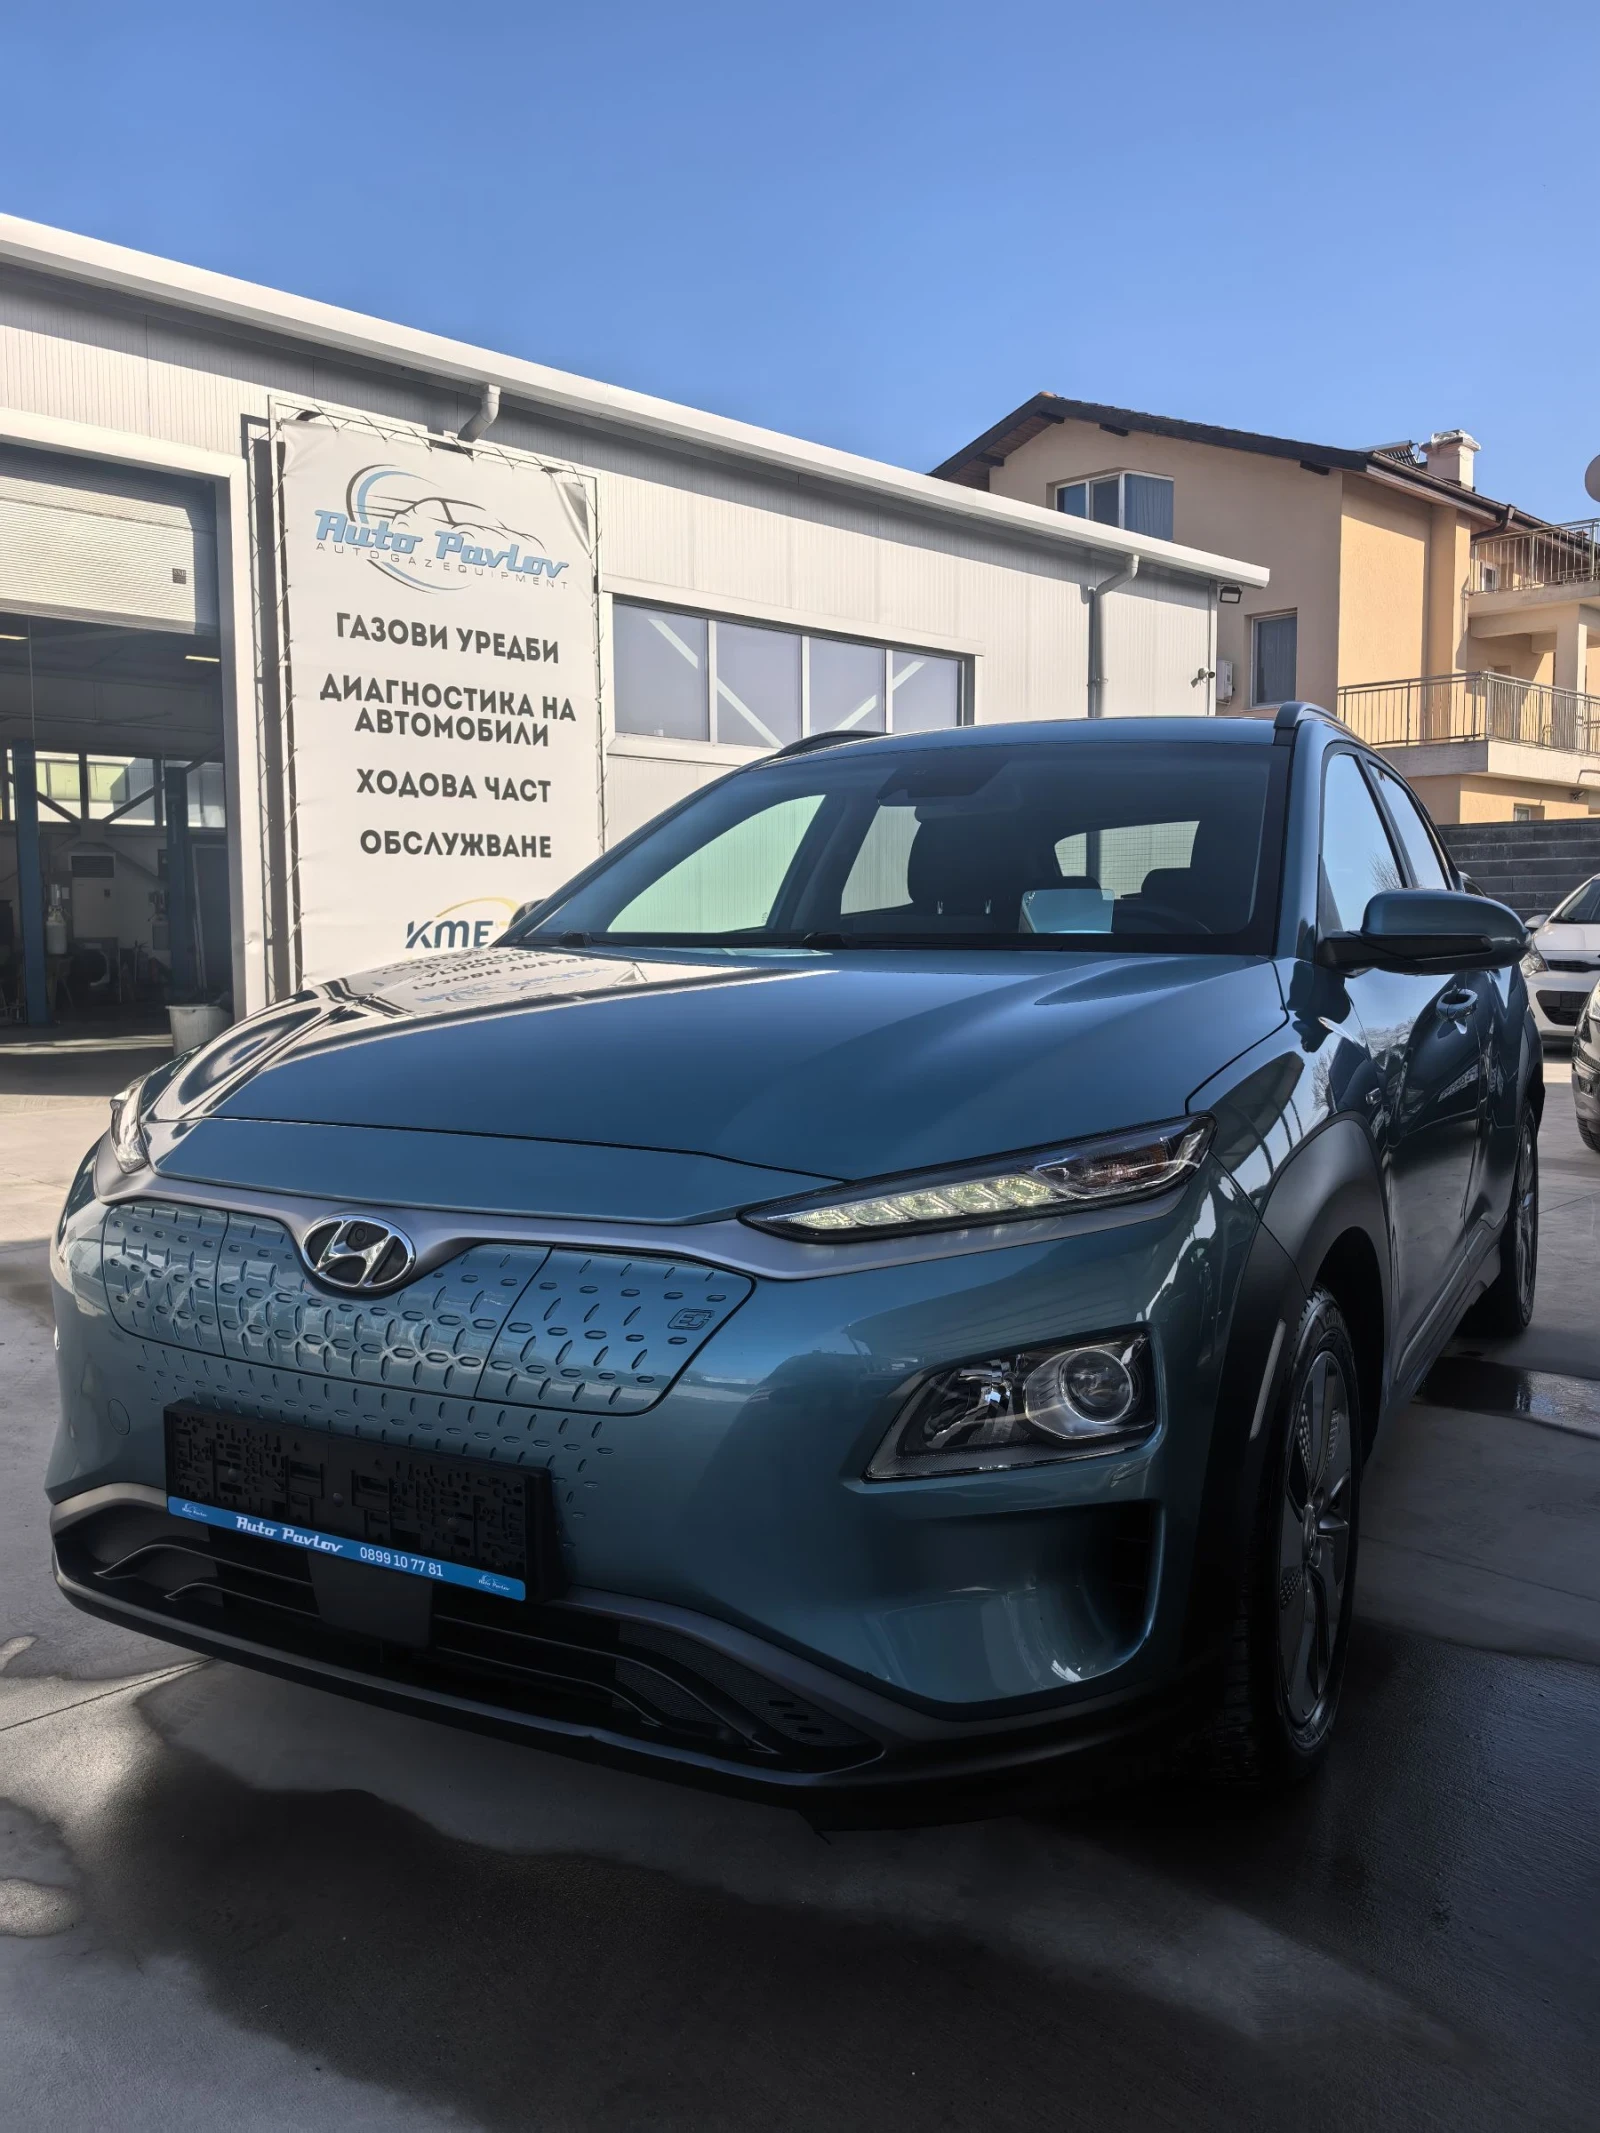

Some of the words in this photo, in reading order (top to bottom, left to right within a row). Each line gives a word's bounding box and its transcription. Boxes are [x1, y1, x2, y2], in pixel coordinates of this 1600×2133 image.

[314, 509, 424, 555] Auto
[434, 530, 570, 579] Pavlov
[336, 612, 448, 650] ГАЗОВИ
[456, 627, 559, 664] УРЕДБИ
[319, 673, 534, 718] ДИАГНОСТИКА
[542, 696, 577, 722] НА
[354, 707, 549, 747] АВТОМОБИЛИ
[356, 768, 477, 799] ХОДОВА
[484, 776, 552, 803] ЧАСТ
[360, 829, 552, 859] ОБСЛУЖВАНЕ
[236, 1515, 277, 1537] Auto
[282, 1527, 343, 1552] Pavlov
[360, 1547, 391, 1564] 0899
[393, 1554, 408, 1568] 10
[410, 1558, 426, 1572] 77
[428, 1562, 444, 1577] 81
